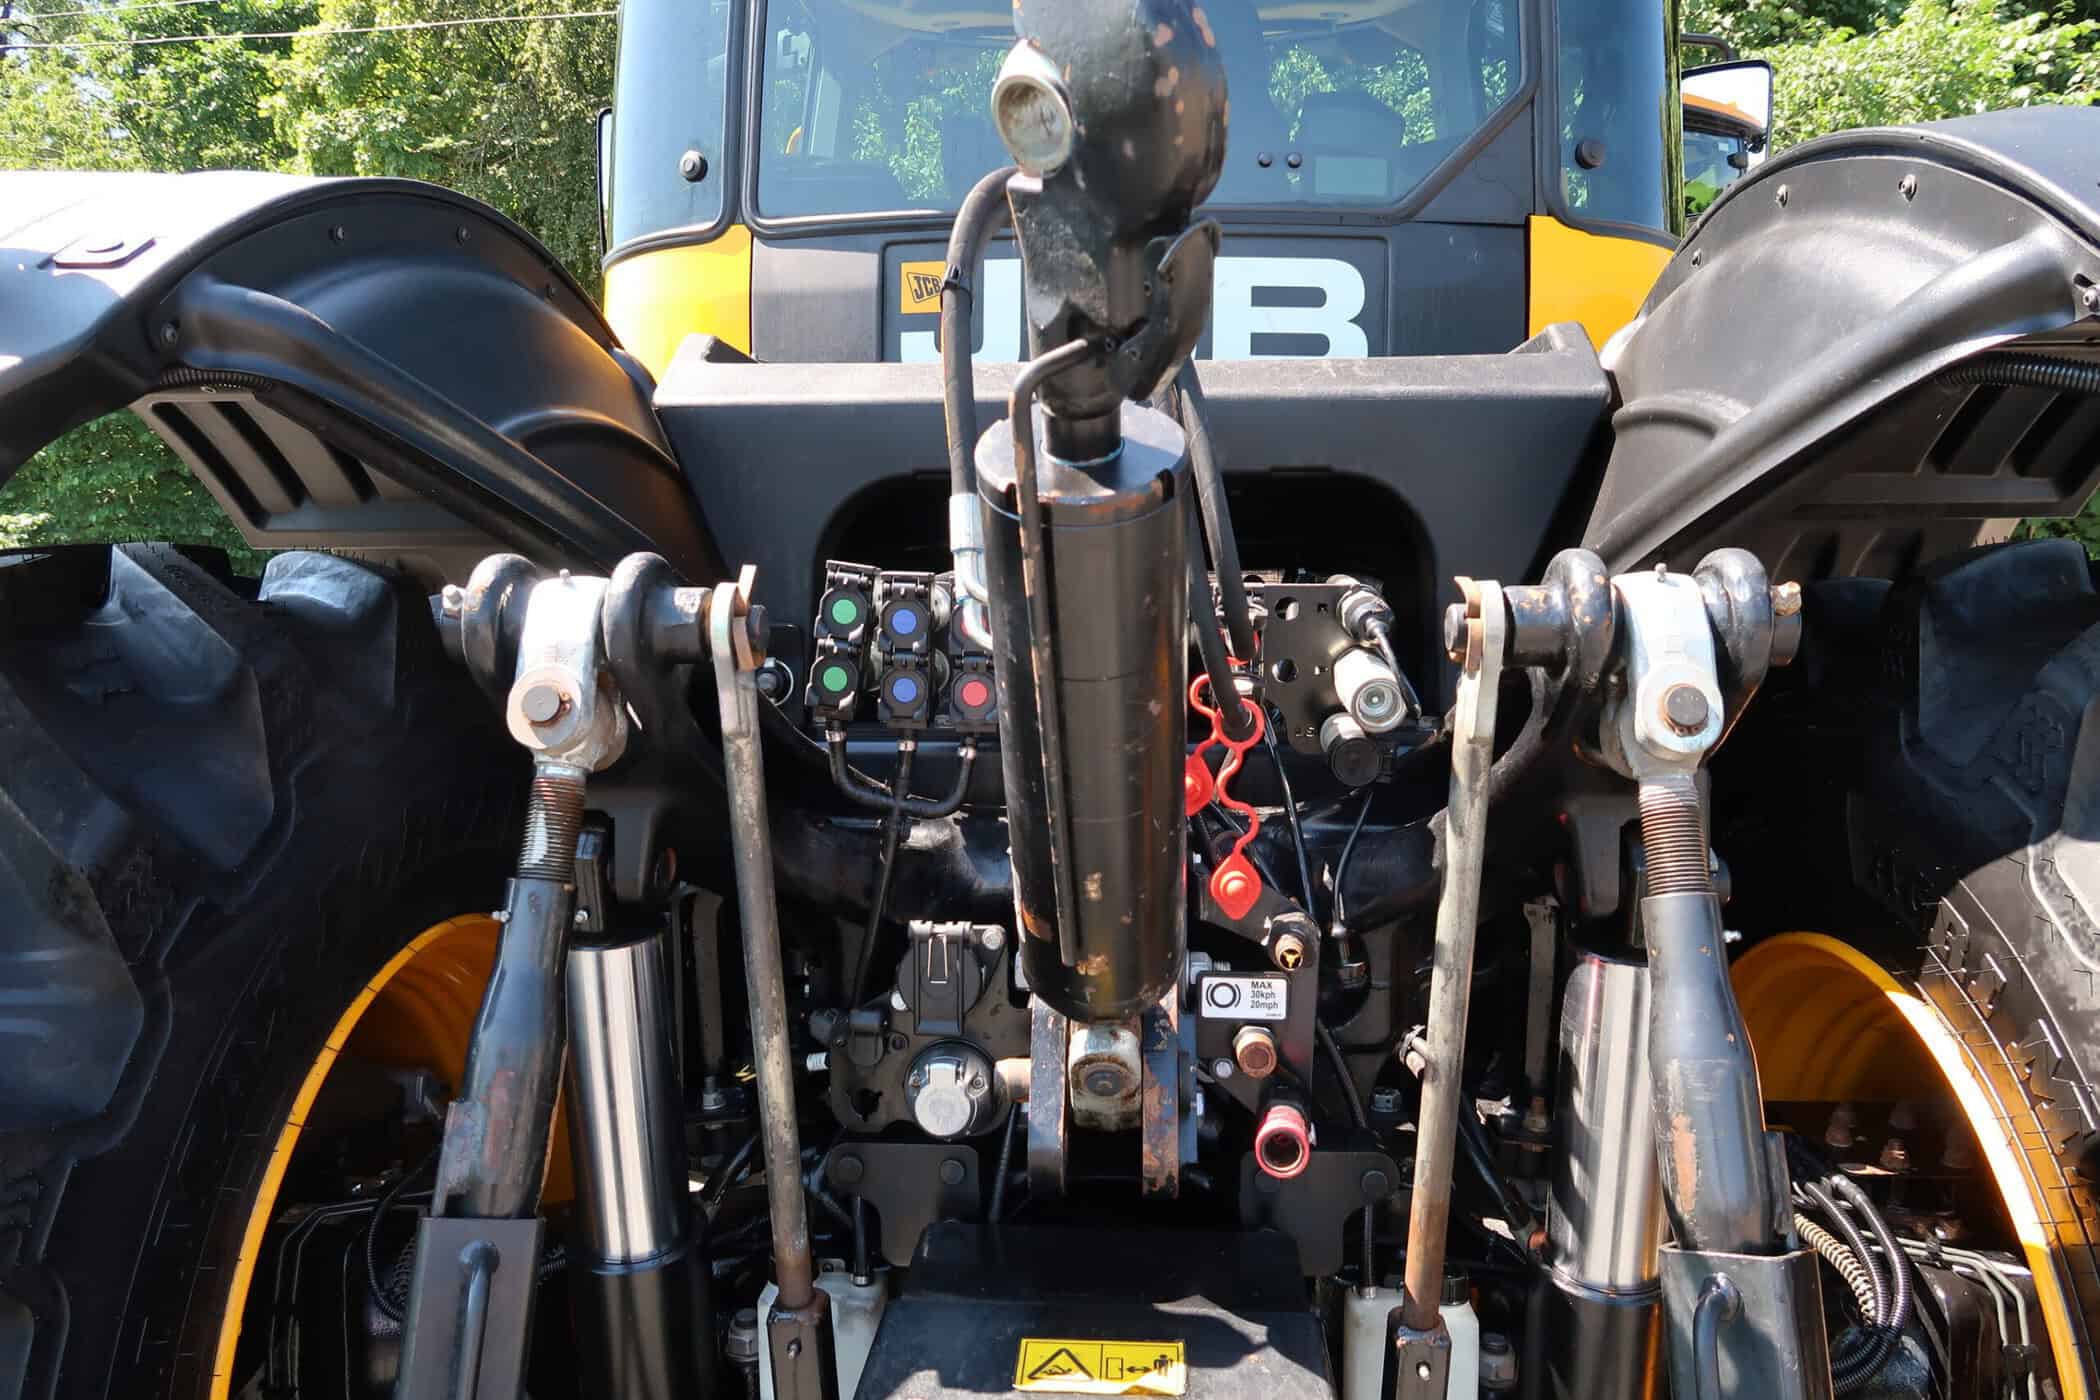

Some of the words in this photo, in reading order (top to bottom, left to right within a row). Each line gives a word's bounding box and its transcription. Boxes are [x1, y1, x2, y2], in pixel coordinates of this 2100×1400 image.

[912, 275, 942, 300] JCB
[900, 257, 1369, 360] JB
[1250, 980, 1273, 990] MAX
[1250, 990, 1276, 1000] 30kph
[1250, 1000, 1279, 1010] 20mph
